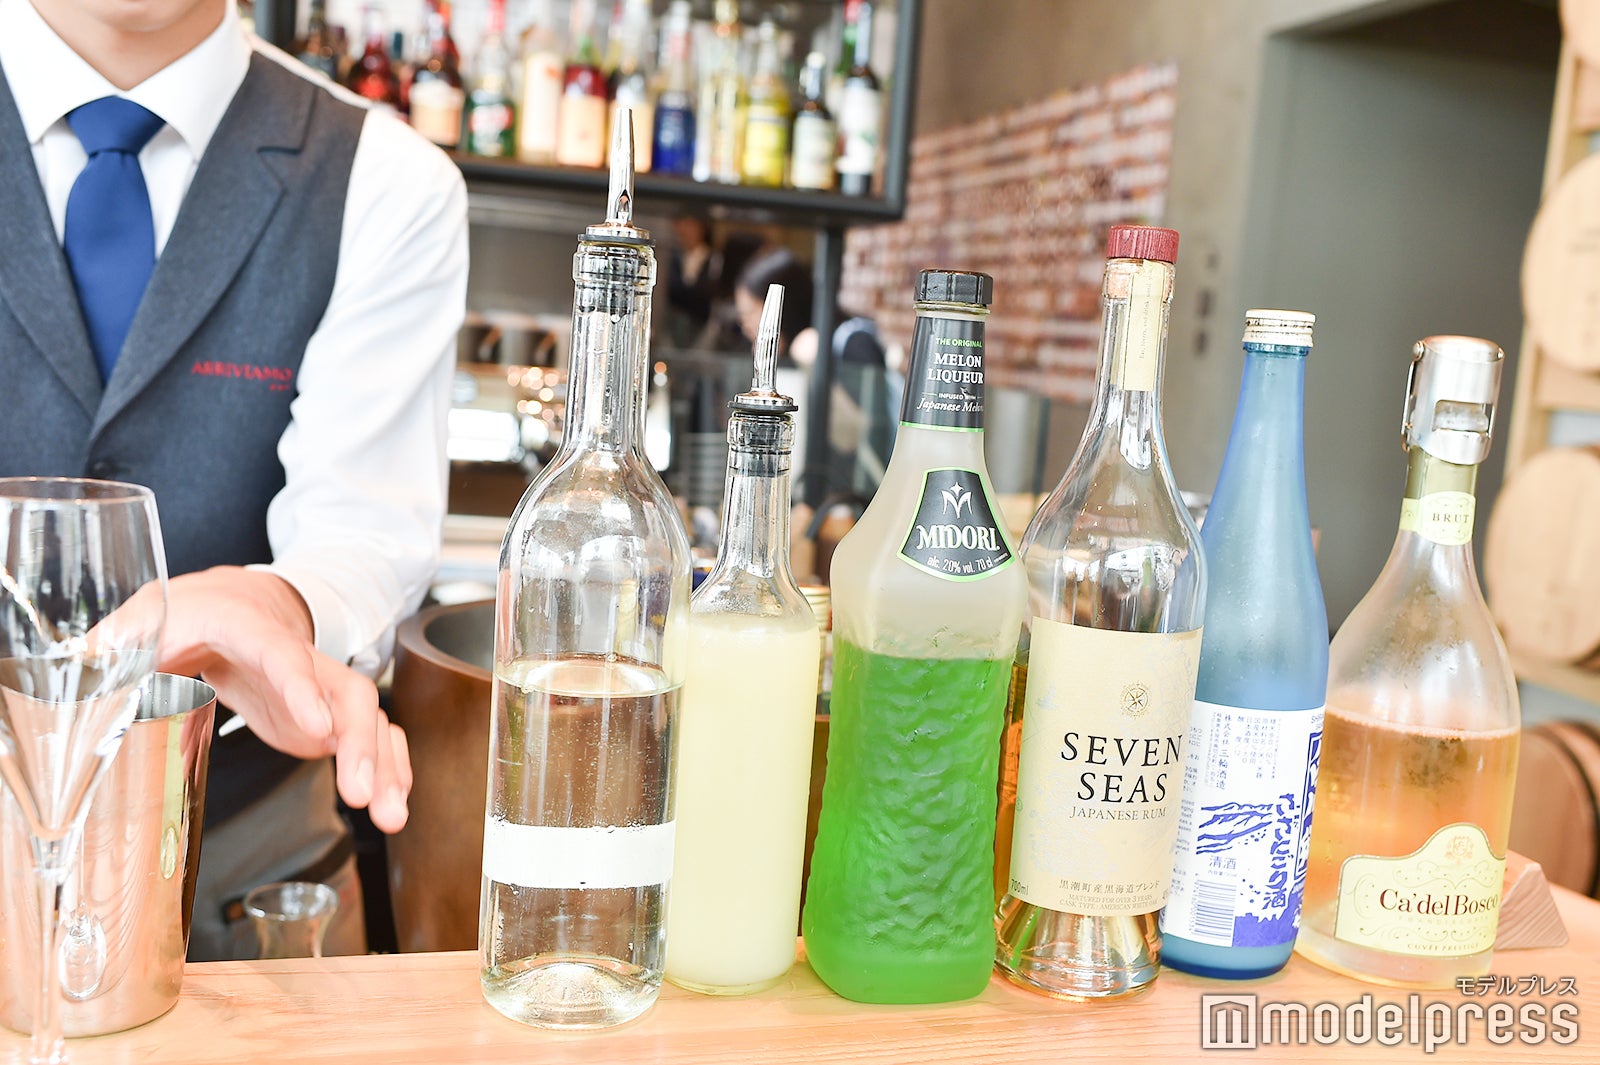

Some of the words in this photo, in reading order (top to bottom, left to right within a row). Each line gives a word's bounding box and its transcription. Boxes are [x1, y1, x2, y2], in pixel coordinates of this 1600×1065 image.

[935, 338, 951, 346] THE
[951, 338, 983, 348] ORIGINAL
[934, 352, 982, 368] MELON
[927, 368, 984, 384] LIQUEUR
[917, 398, 961, 412] Japanese
[1432, 512, 1470, 524] BRUT
[927, 555, 940, 569] alc.
[943, 558, 961, 574] 20%
[962, 563, 975, 574] vol.
[976, 558, 987, 571] 70
[987, 556, 994, 567] cl
[1060, 732, 1183, 767] SEVEN
[1077, 772, 1168, 803] SEAS
[1069, 806, 1139, 821] JAPANESE
[1143, 807, 1167, 820] RUM
[1209, 855, 1237, 870] 清酒
[1454, 894, 1499, 915] Bosco
